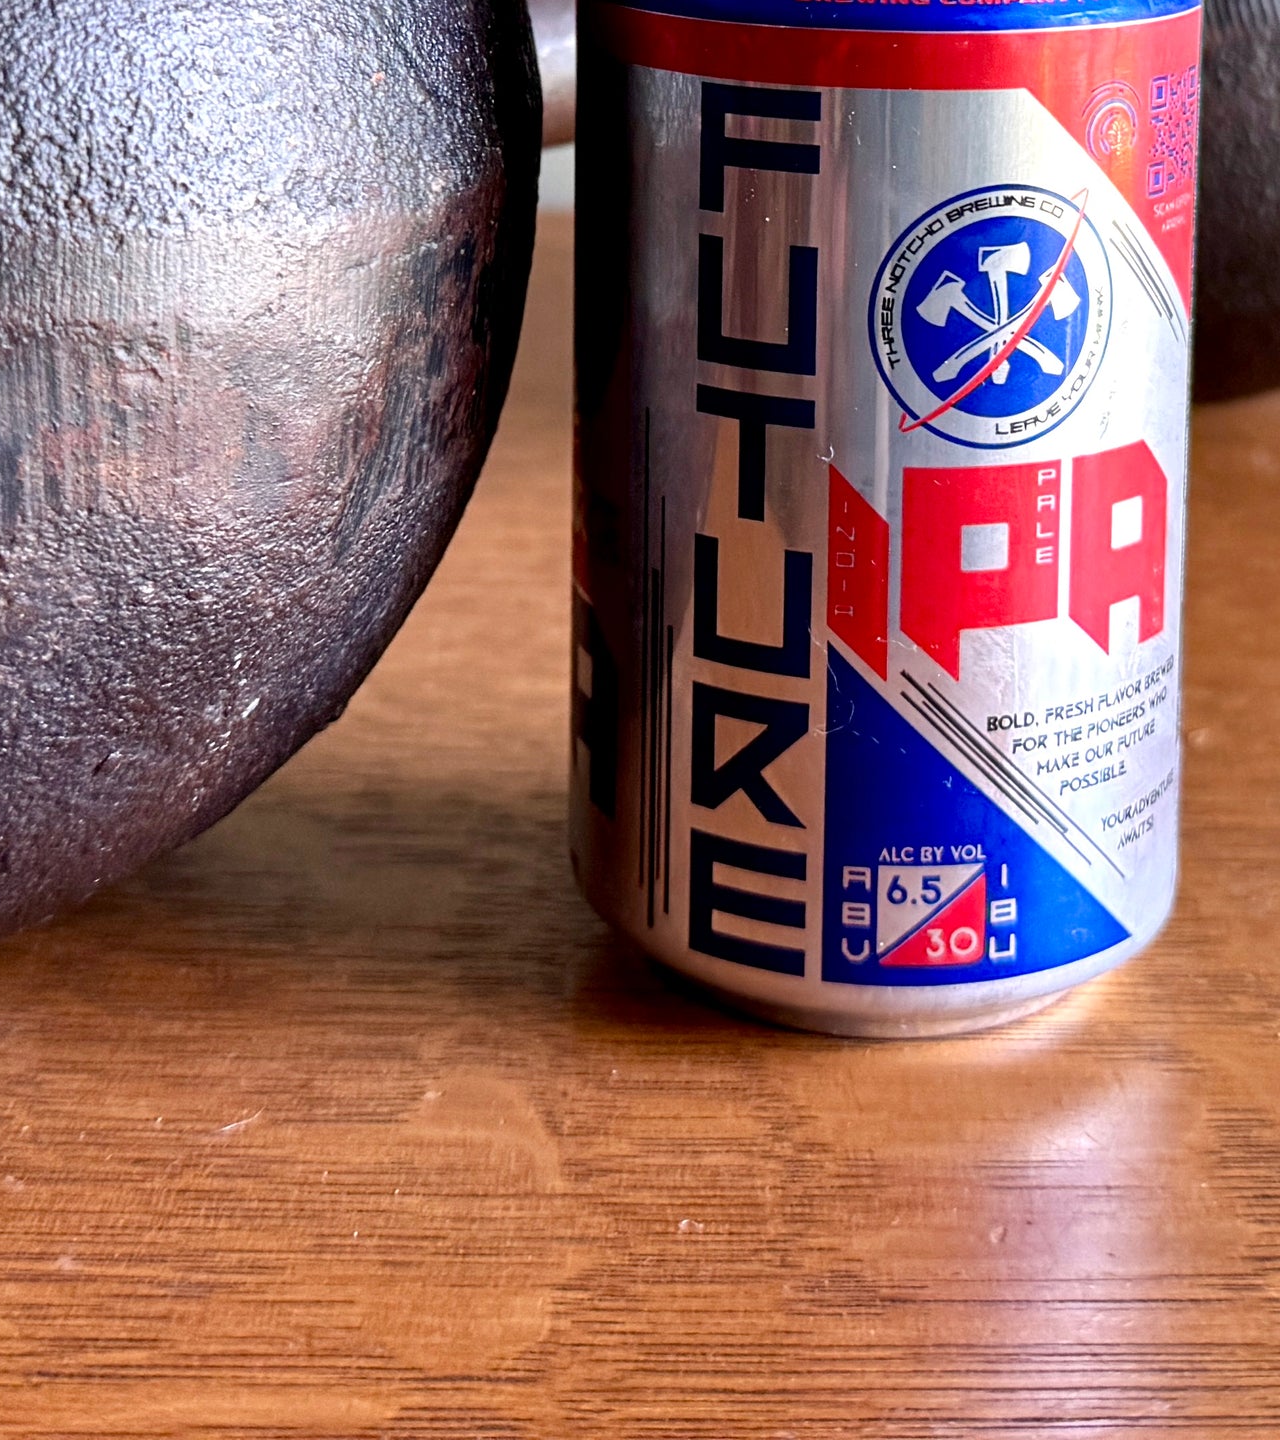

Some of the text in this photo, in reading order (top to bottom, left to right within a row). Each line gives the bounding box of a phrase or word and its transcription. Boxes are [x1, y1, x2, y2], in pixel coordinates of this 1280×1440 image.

[880, 296, 901, 370] THREE
[687, 81, 822, 977] FUTURE
[1035, 469, 1056, 564] PALE
[986, 654, 1174, 732] BOLD, FRESH FLAVOR BREWED
[1012, 685, 1167, 754] FOR THE PIONEERS WHO
[1037, 718, 1155, 775] MAKE OUR FUTURE
[1059, 760, 1127, 796] POSSIBLE
[879, 844, 987, 862] ALC BY VOL
[887, 874, 941, 905] 6.5
[926, 927, 978, 957] 30
